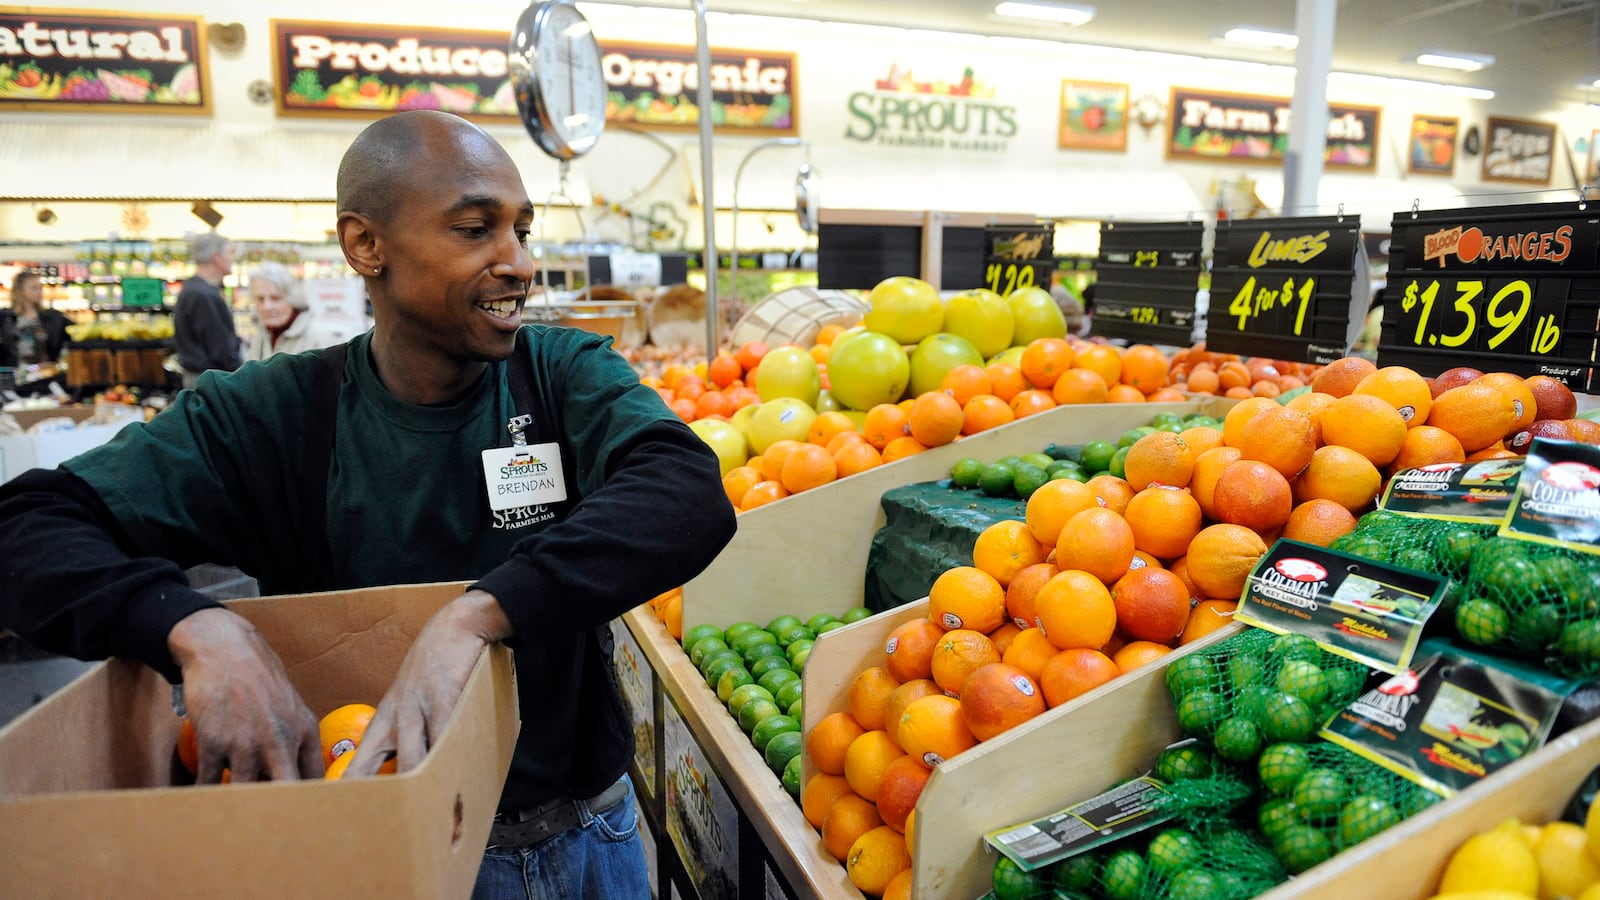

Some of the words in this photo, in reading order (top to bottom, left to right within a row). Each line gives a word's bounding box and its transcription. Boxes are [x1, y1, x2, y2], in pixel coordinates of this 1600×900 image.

[291, 34, 509, 77] Produce
[602, 53, 787, 96] Organic
[844, 91, 1017, 142] SPROUTS
[1182, 99, 1272, 132] Farm
[1248, 231, 1330, 268] LIMES
[1427, 230, 1460, 255] BLOOD
[1457, 225, 1574, 263] ORANGES
[1229, 276, 1256, 331] 4
[1254, 287, 1279, 317] for
[1280, 277, 1315, 336] $1
[1402, 279, 1532, 350] $1.39
[1530, 314, 1561, 354] lb
[1541, 365, 1569, 376] Product
[1570, 368, 1581, 376] of
[497, 477, 555, 496] BRENDAN
[500, 463, 548, 480] SPROUTS
[1403, 467, 1456, 482] COLIMAN
[506, 516, 540, 531] FARMERS
[1261, 566, 1323, 600] COLIMAN
[1265, 588, 1280, 598] KEY
[1281, 593, 1305, 606] LIMES
[1252, 595, 1260, 603] The
[1261, 599, 1272, 607] Real
[1272, 602, 1288, 613] Flavor
[1288, 607, 1294, 615] of
[1294, 609, 1313, 620] Mexico
[679, 753, 723, 853] SPROUTS
